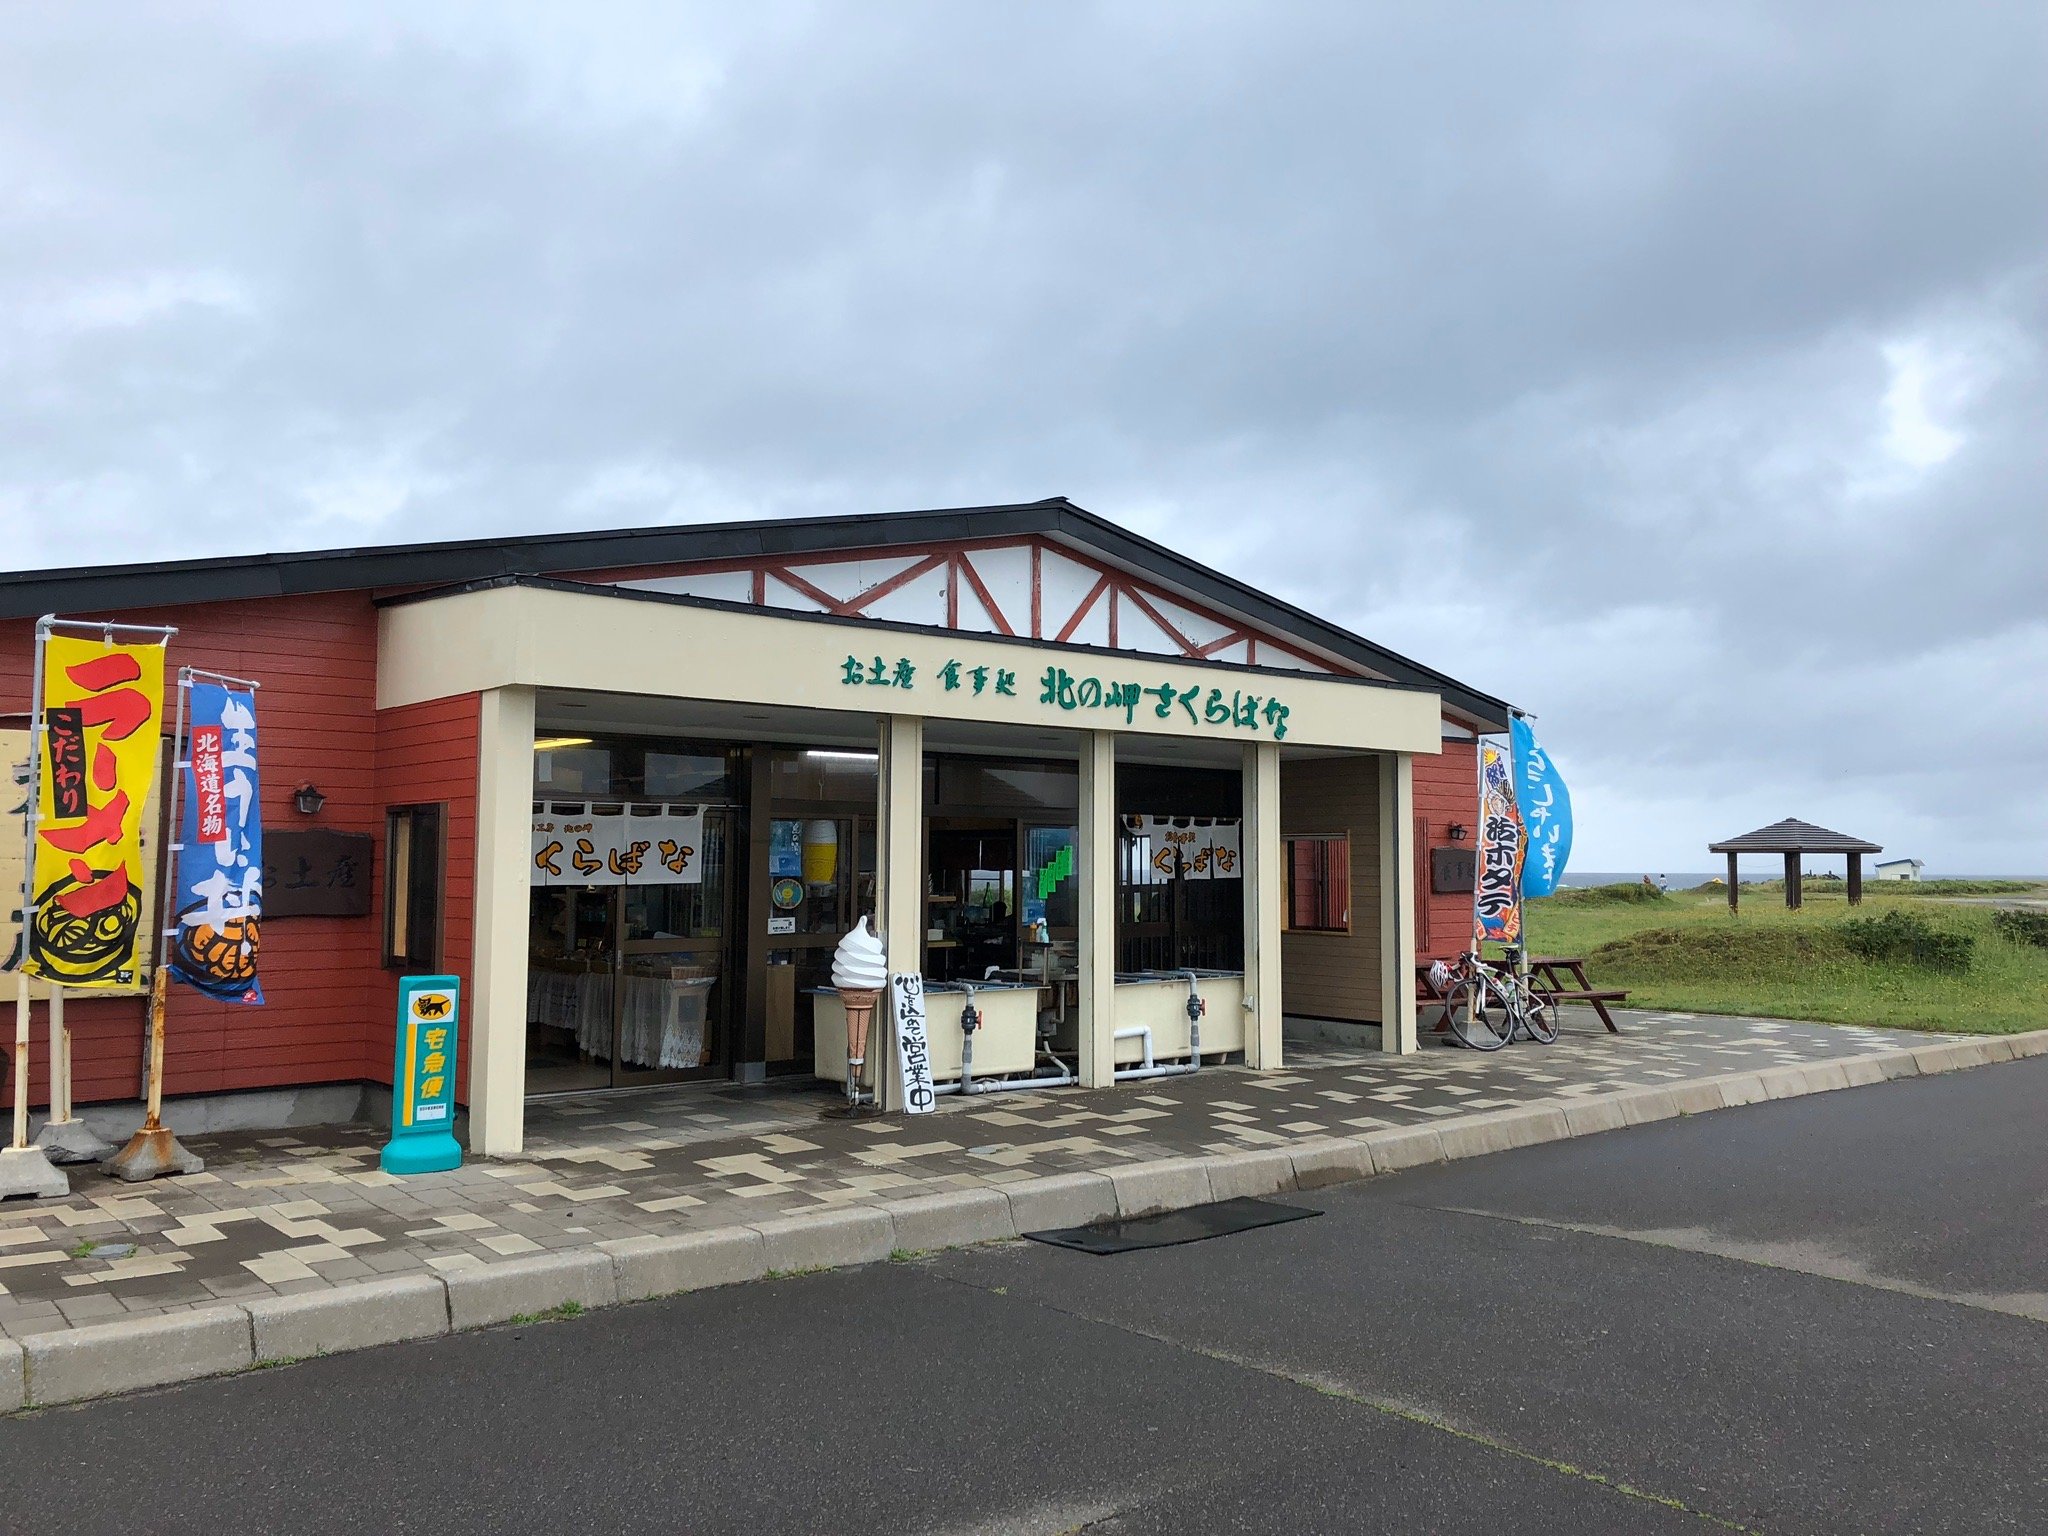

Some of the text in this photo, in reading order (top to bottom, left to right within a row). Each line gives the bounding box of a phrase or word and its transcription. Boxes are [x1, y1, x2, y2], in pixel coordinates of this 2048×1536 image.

[841, 655, 916, 689] お土産
[936, 658, 1017, 697] 食事処
[39, 653, 151, 919] ラーメン
[51, 713, 82, 814] こだわり
[196, 733, 224, 836] 北海道名物
[421, 1028, 447, 1099] 宅急便
